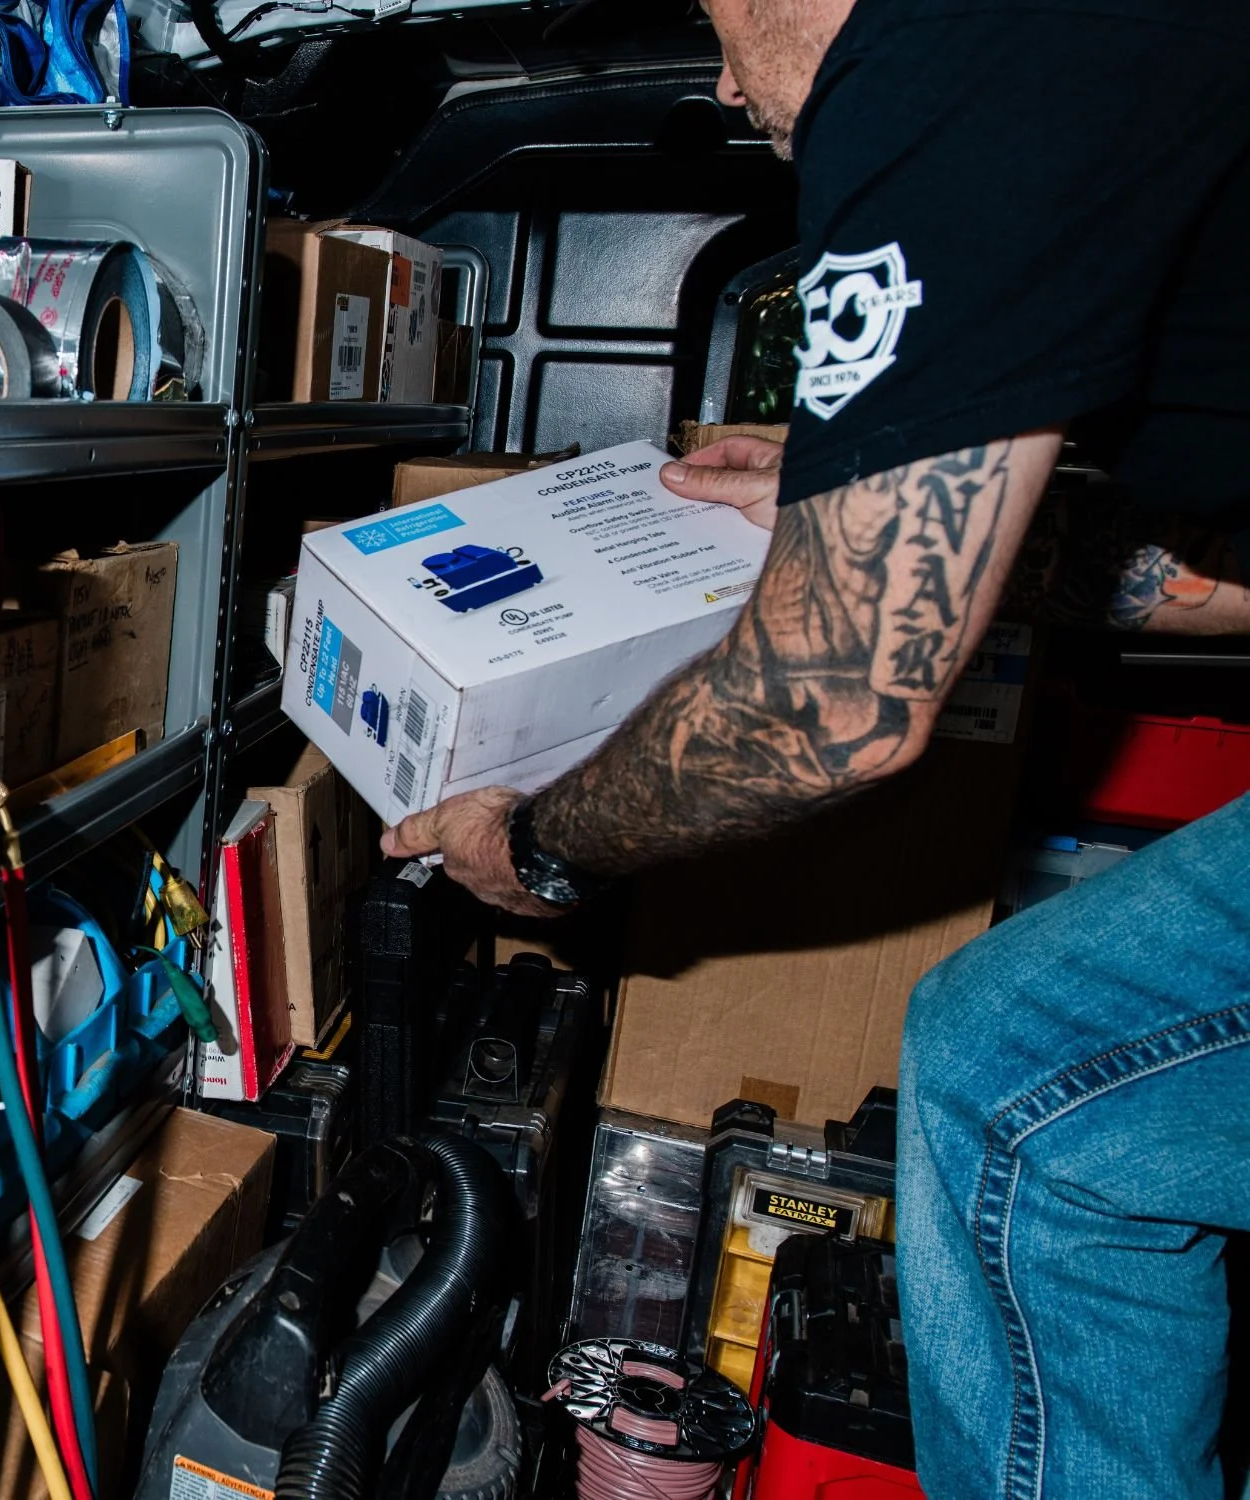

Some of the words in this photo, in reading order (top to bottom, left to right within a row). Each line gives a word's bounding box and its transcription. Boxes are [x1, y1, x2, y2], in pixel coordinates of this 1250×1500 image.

[858, 286, 918, 310] YEARS
[835, 370, 861, 385] 1976
[537, 470, 620, 497] CONDENSATE
[621, 462, 652, 477] PUMP
[556, 460, 616, 481] CP22115
[551, 506, 585, 520] Audible
[587, 499, 612, 512] Alarm
[631, 489, 648, 502] db)
[563, 490, 615, 508] FEATURES
[569, 521, 605, 535] Overflow
[606, 514, 629, 527] Safety
[630, 507, 654, 520] Switch
[594, 541, 617, 554] Metal
[618, 534, 647, 549] Hanging
[649, 530, 666, 540] Tabs
[614, 546, 657, 563] Condensate
[621, 565, 635, 575] Anti
[636, 557, 670, 572] Vibration
[671, 549, 698, 562] Rubber
[633, 574, 660, 586] Check
[661, 569, 680, 579] Valve
[299, 617, 313, 674] CP22115
[324, 626, 333, 650] Feet
[305, 632, 320, 707] CONDENSATE
[315, 599, 325, 632] PUMP
[321, 650, 330, 667] 22
[318, 668, 327, 682] To
[328, 656, 338, 688] Head
[340, 660, 350, 688] VAC
[317, 686, 325, 699] Up
[770, 1195, 838, 1219] STANLEY
[774, 1208, 827, 1225] FATMAX
[186, 1463, 216, 1481] WARNING
